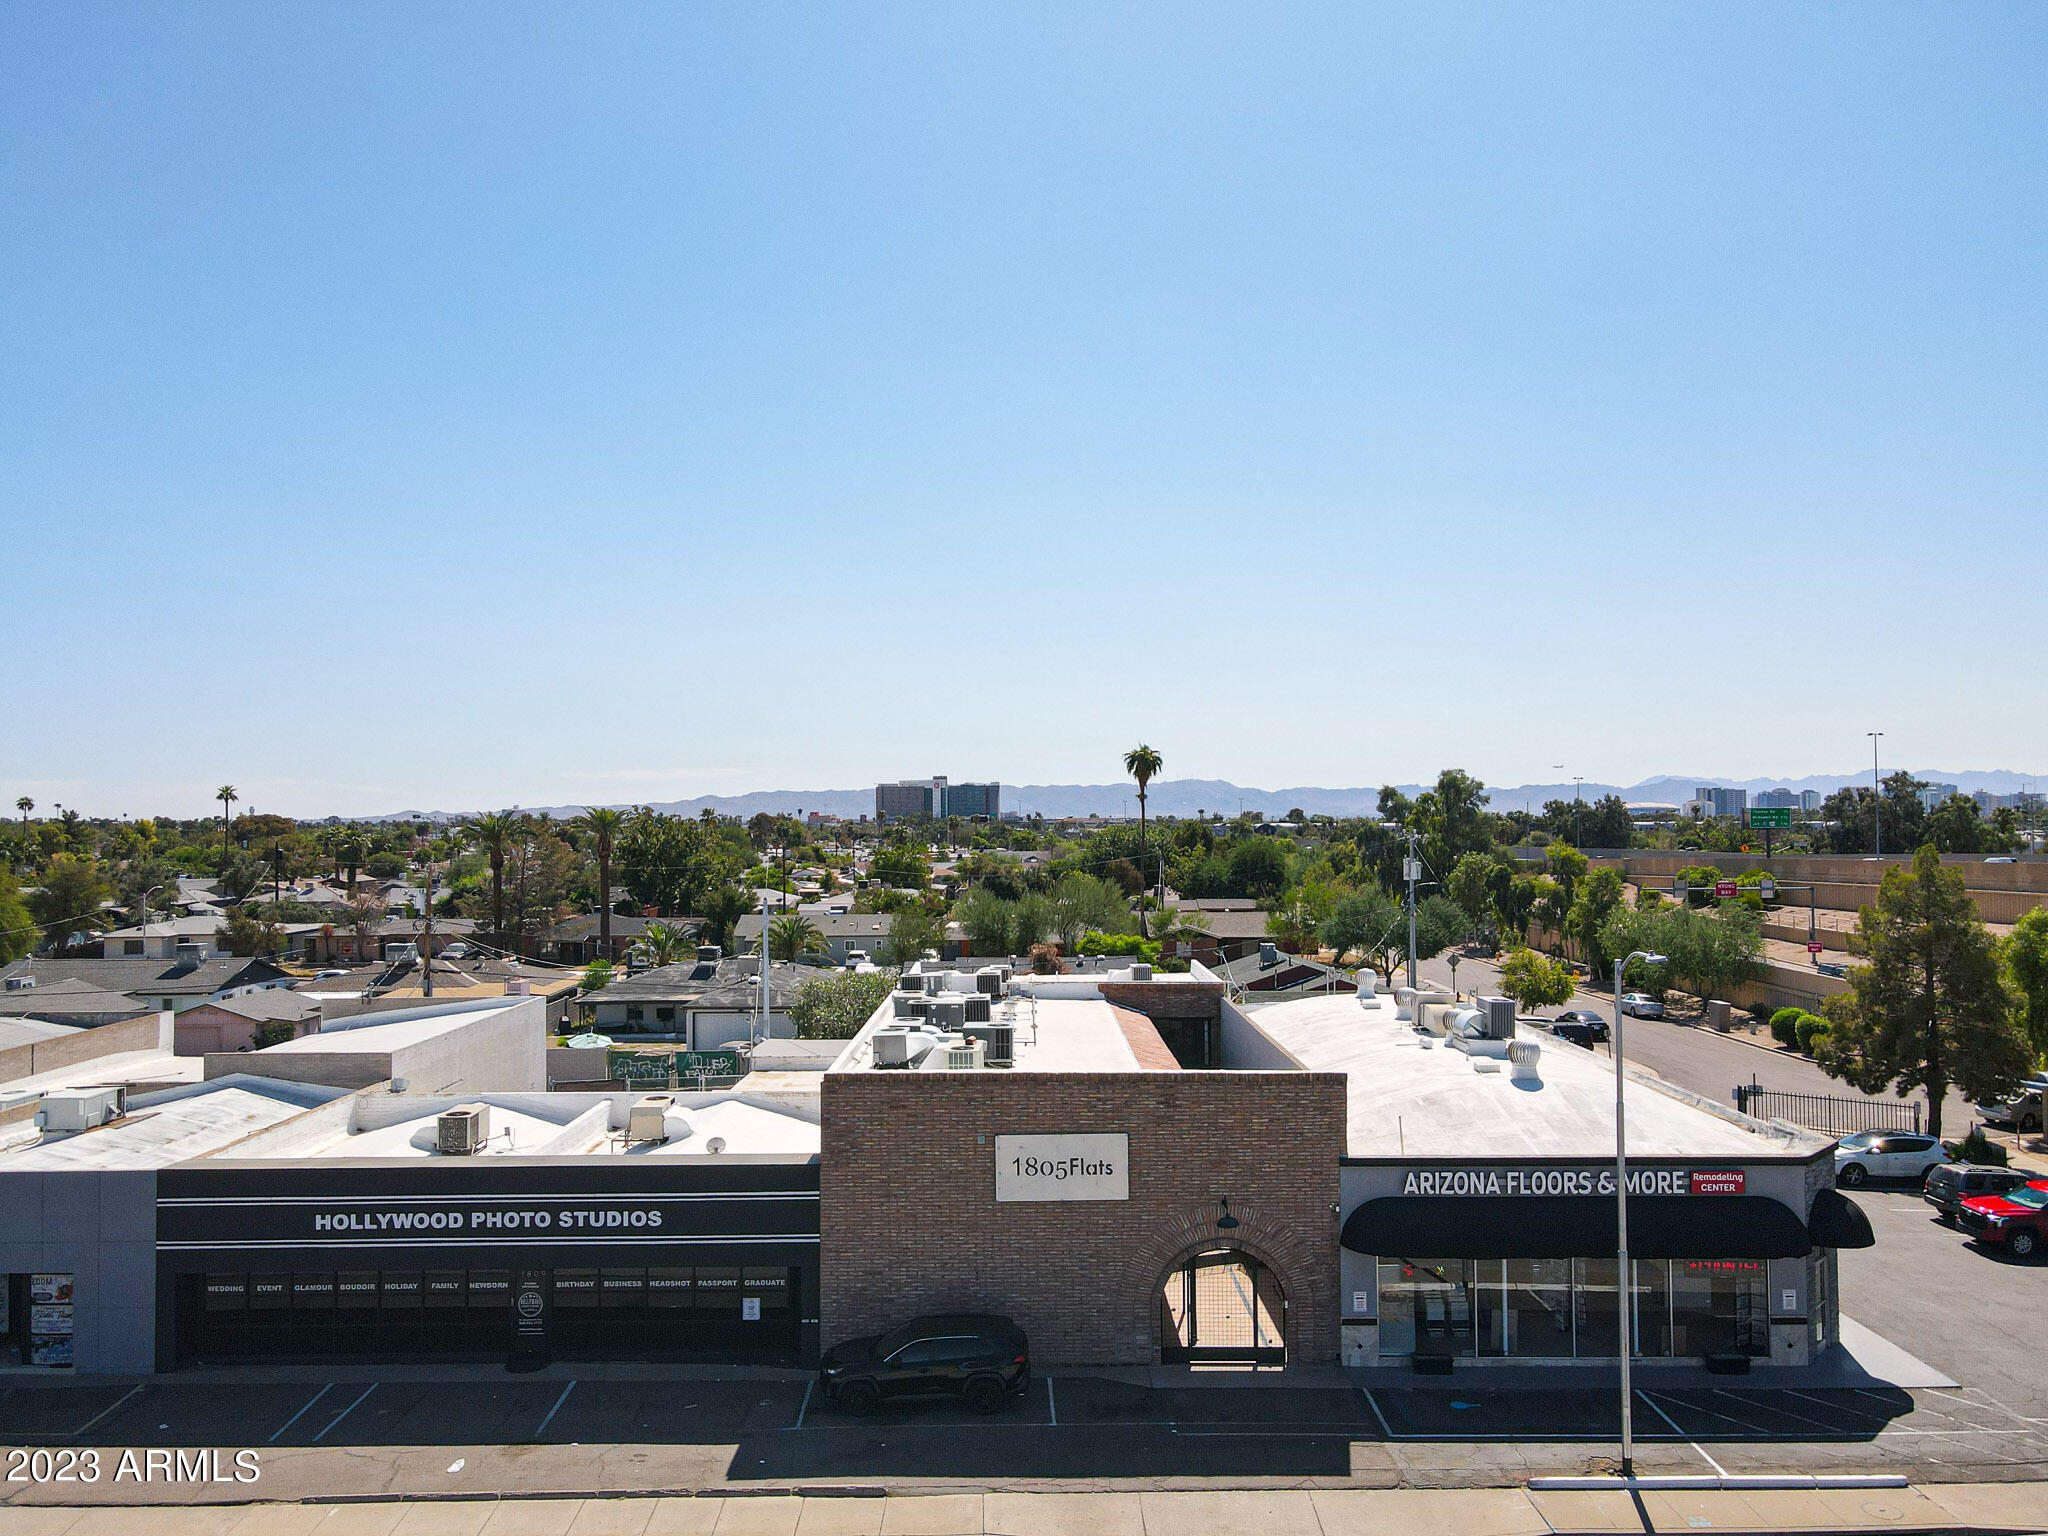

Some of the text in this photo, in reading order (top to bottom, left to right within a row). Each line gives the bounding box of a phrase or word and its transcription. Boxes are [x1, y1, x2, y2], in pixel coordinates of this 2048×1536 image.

[1012, 1156, 1114, 1180] 1805Flats
[1692, 1172, 1744, 1183] Remodeling
[1403, 1171, 1686, 1195] ARIZONA FLOORS & MORE
[1700, 1183, 1737, 1192] CENTER
[315, 1210, 663, 1231] HOLLYWOOD PHOTO STUDIOS
[256, 1284, 283, 1292] EVENT
[339, 1283, 376, 1291] BOUDOIR
[384, 1282, 419, 1290] HOLIDAY
[469, 1281, 509, 1289] NEWBORN
[556, 1280, 596, 1288] BIRTHDAY
